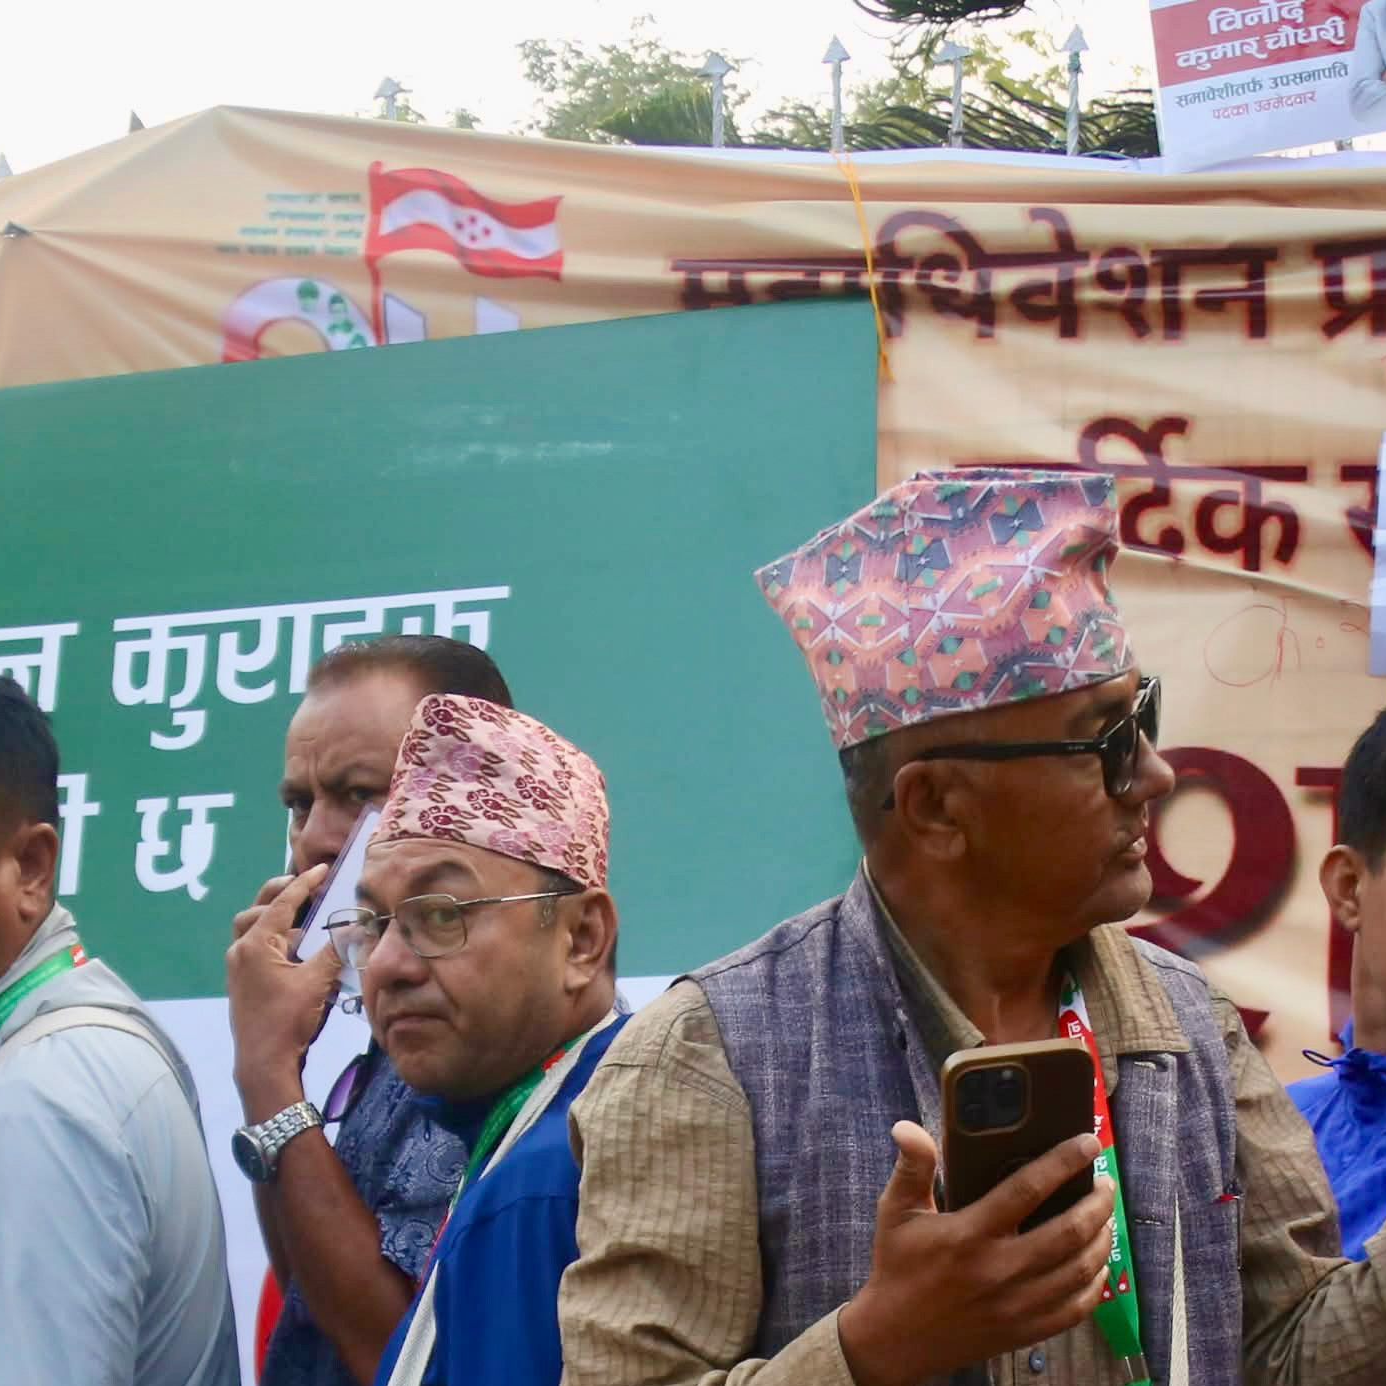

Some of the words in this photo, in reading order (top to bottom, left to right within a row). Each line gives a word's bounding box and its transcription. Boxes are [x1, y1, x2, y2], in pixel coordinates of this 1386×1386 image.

[1175, 36, 1267, 70] कुमार
[1264, 16, 1346, 50] चौधरी
[1175, 77, 1262, 108] समावेशीतर्फ
[1269, 62, 1349, 89] उपसभापति
[1212, 102, 1249, 120] पदका
[1254, 90, 1317, 112] उम्मेदवार
[134, 792, 234, 901] छ
